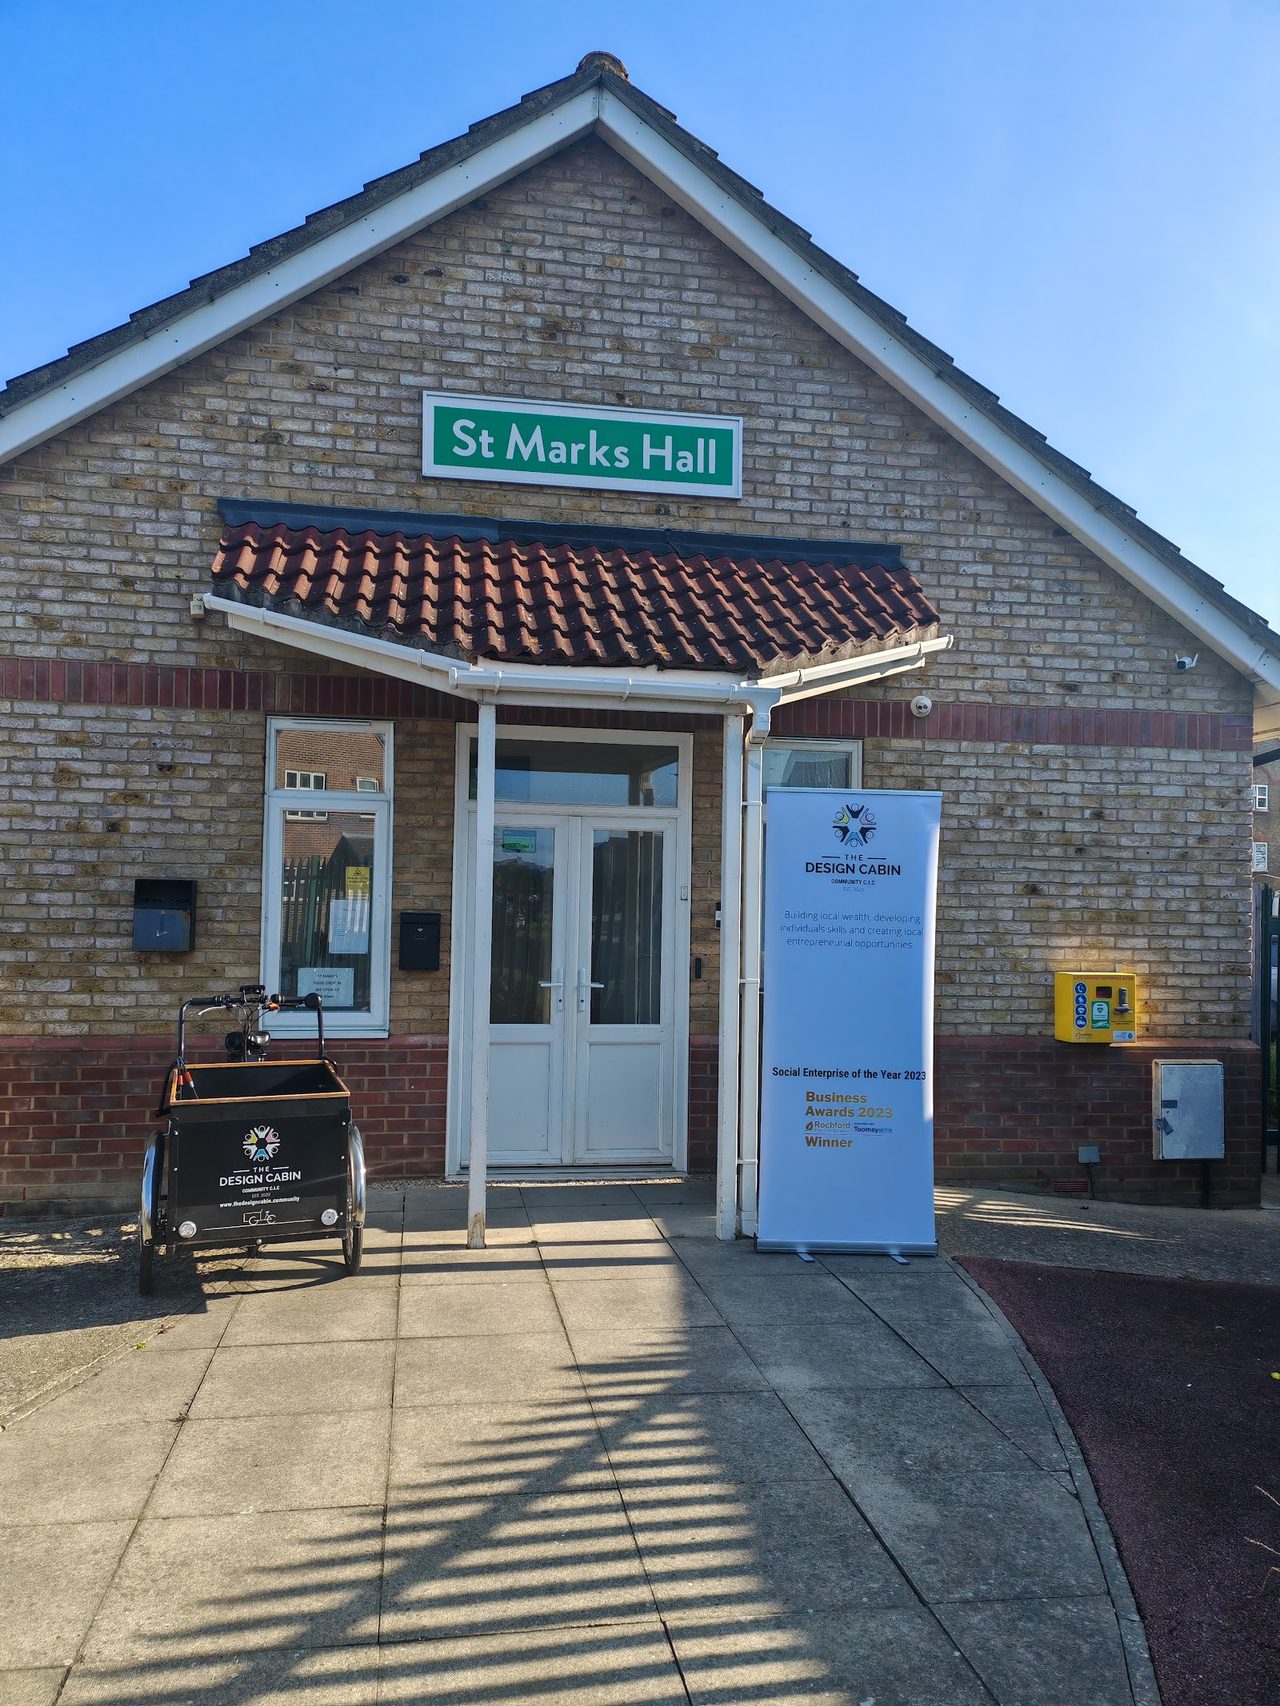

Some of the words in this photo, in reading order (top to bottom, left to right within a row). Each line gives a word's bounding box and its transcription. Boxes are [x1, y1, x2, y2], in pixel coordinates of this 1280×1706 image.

[452, 418, 494, 458] St
[505, 423, 630, 469] Marks
[642, 433, 716, 474] Hall
[805, 862, 856, 874] DESIGN
[859, 864, 901, 876] CABIN
[784, 911, 818, 922] Building
[820, 912, 840, 920] local
[873, 914, 921, 925] developing
[780, 924, 825, 934] individuals
[827, 925, 847, 934] skills
[849, 926, 865, 935] and
[867, 927, 902, 938] creating
[904, 928, 924, 936] local
[786, 937, 853, 948] entrepreneurial
[855, 939, 912, 950] opportunities
[772, 1067, 801, 1077] Social
[803, 1067, 850, 1080] Enterprise
[852, 1069, 861, 1078] of
[863, 1069, 878, 1079] the
[880, 1070, 901, 1080] Year
[904, 1071, 927, 1081] 2023
[805, 1091, 868, 1104] Business
[805, 1105, 855, 1117] Awards
[858, 1107, 893, 1118] 2023
[814, 1120, 850, 1129] Rochford
[805, 1136, 853, 1148] Winner
[219, 1174, 263, 1187] DESIGN
[265, 1171, 301, 1183] CABIN
[219, 1196, 300, 1208] www.thedesigncabin.community
